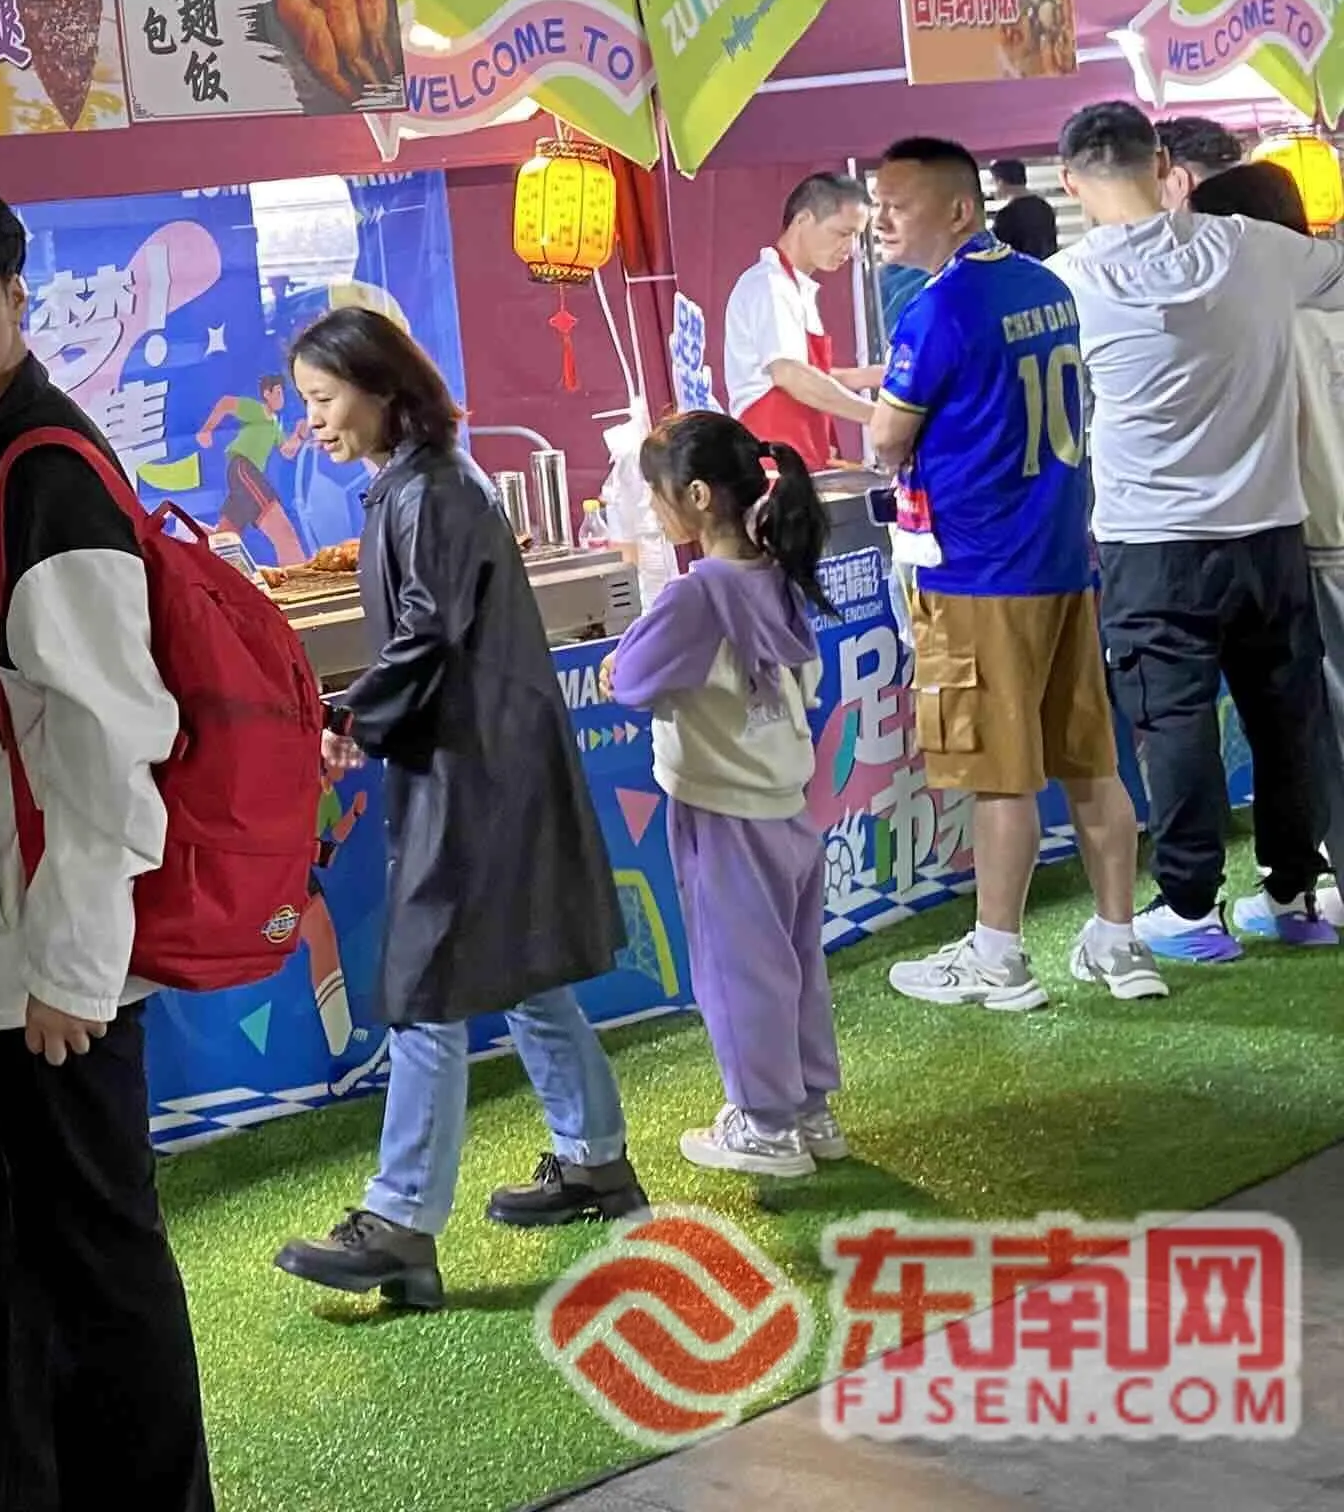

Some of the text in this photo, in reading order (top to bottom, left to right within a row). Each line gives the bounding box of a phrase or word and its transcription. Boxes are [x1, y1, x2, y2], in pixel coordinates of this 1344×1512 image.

[407, 18, 635, 114] WELCOME TO
[1285, 3, 1314, 48] TO
[1018, 344, 1085, 477] 10
